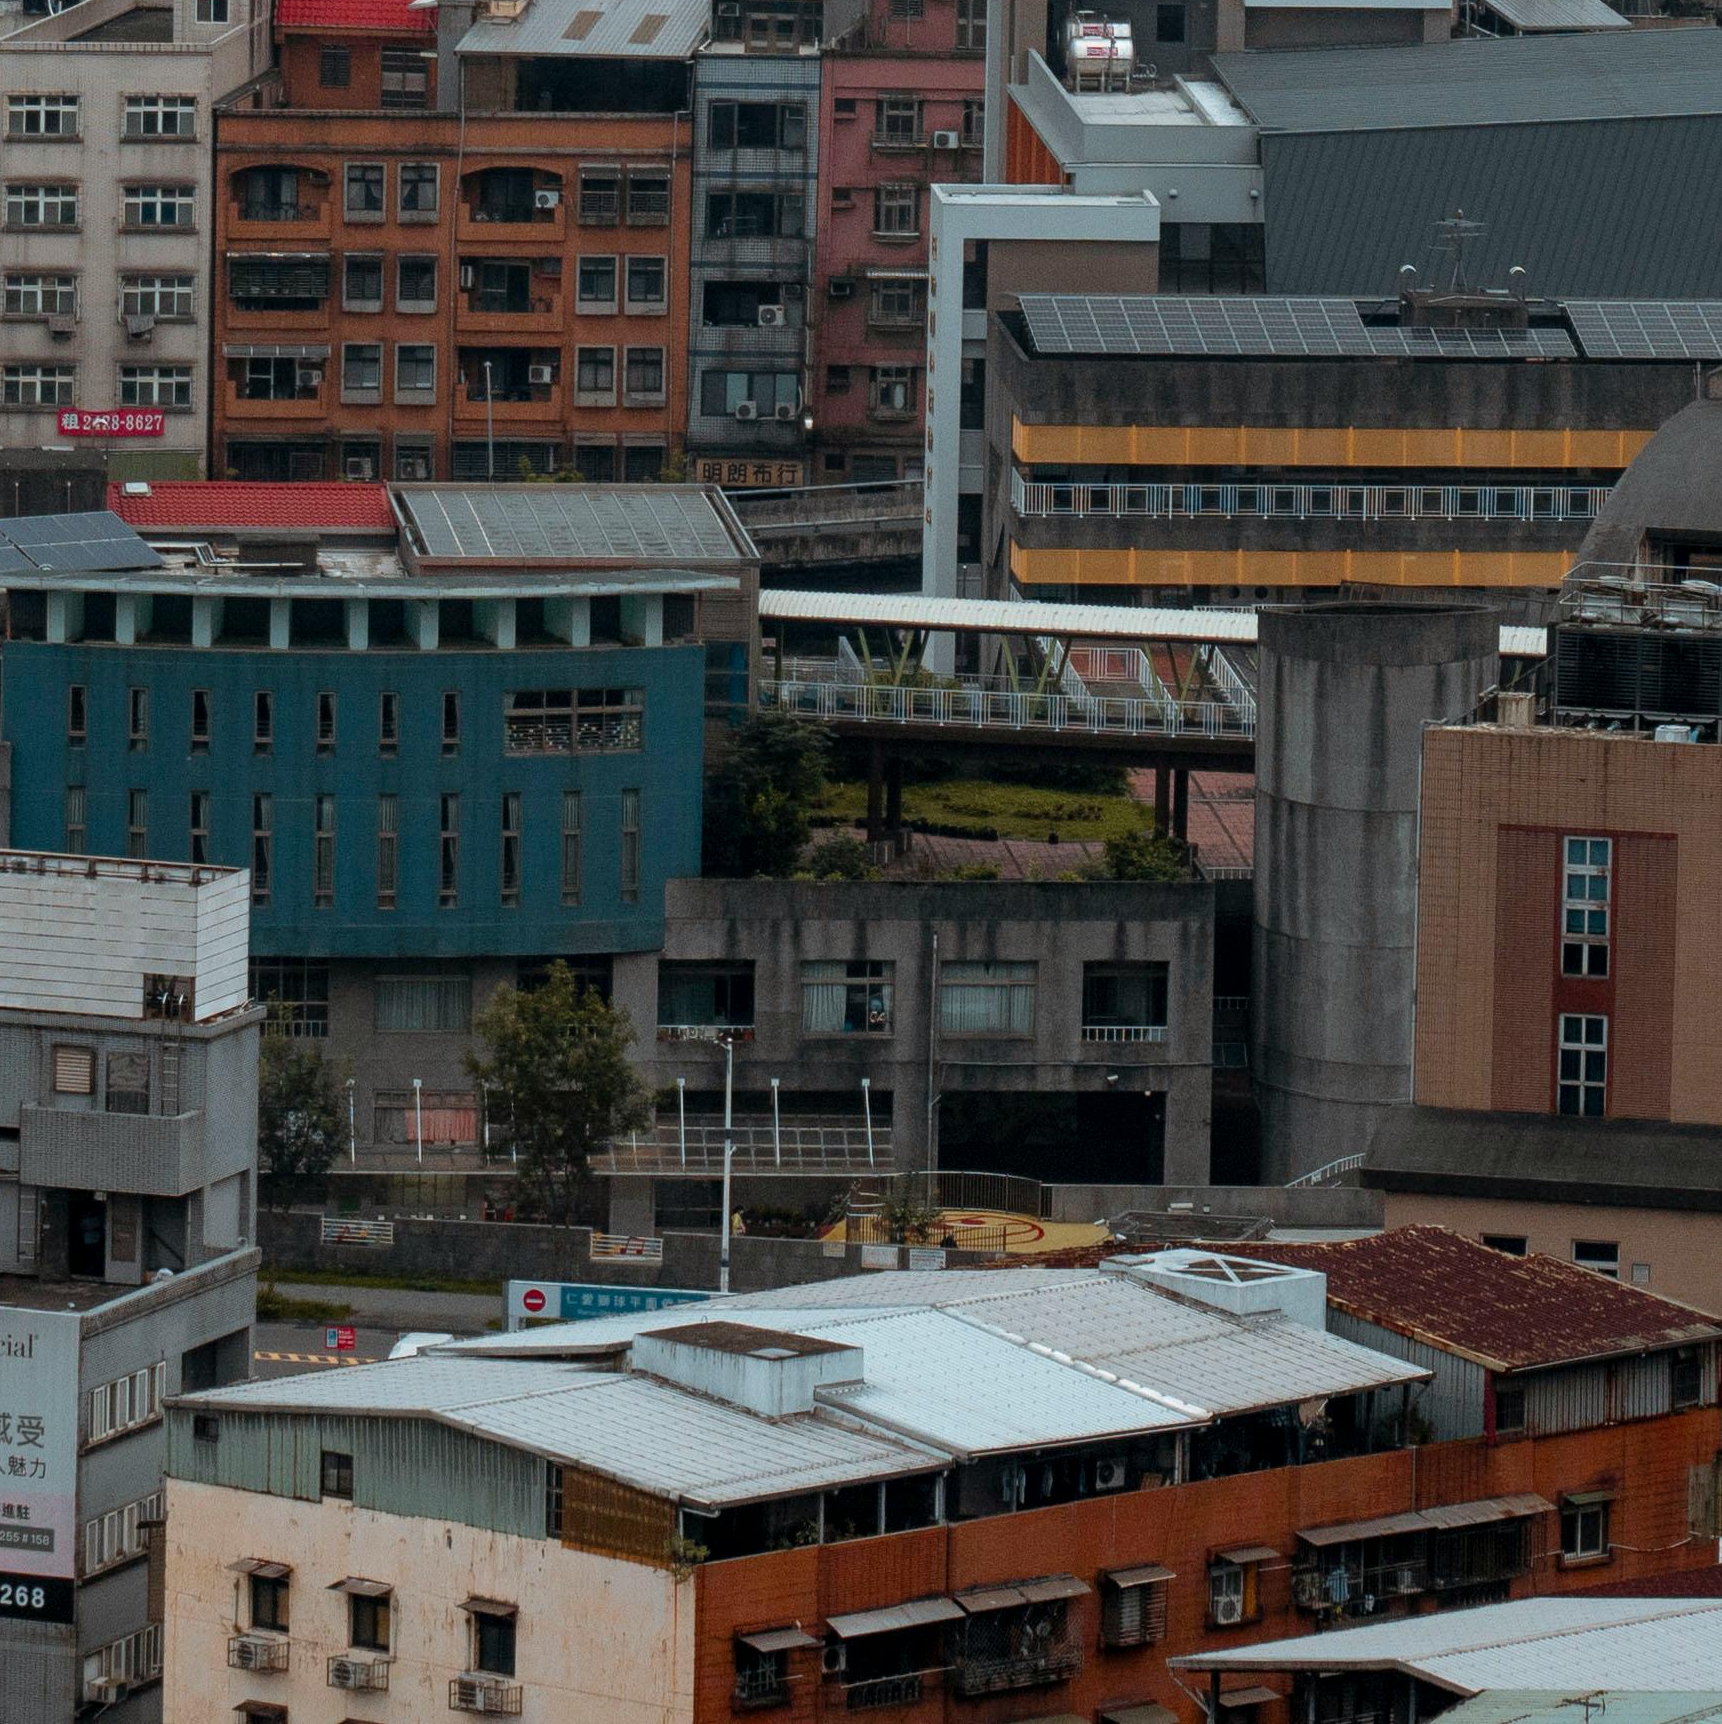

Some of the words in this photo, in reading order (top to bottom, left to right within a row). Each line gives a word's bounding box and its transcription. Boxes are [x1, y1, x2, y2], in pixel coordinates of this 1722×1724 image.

[62, 414, 77, 430] 租
[702, 462, 796, 484] 明朗布行
[566, 1291, 691, 1310] 仁愛獅球平面停
